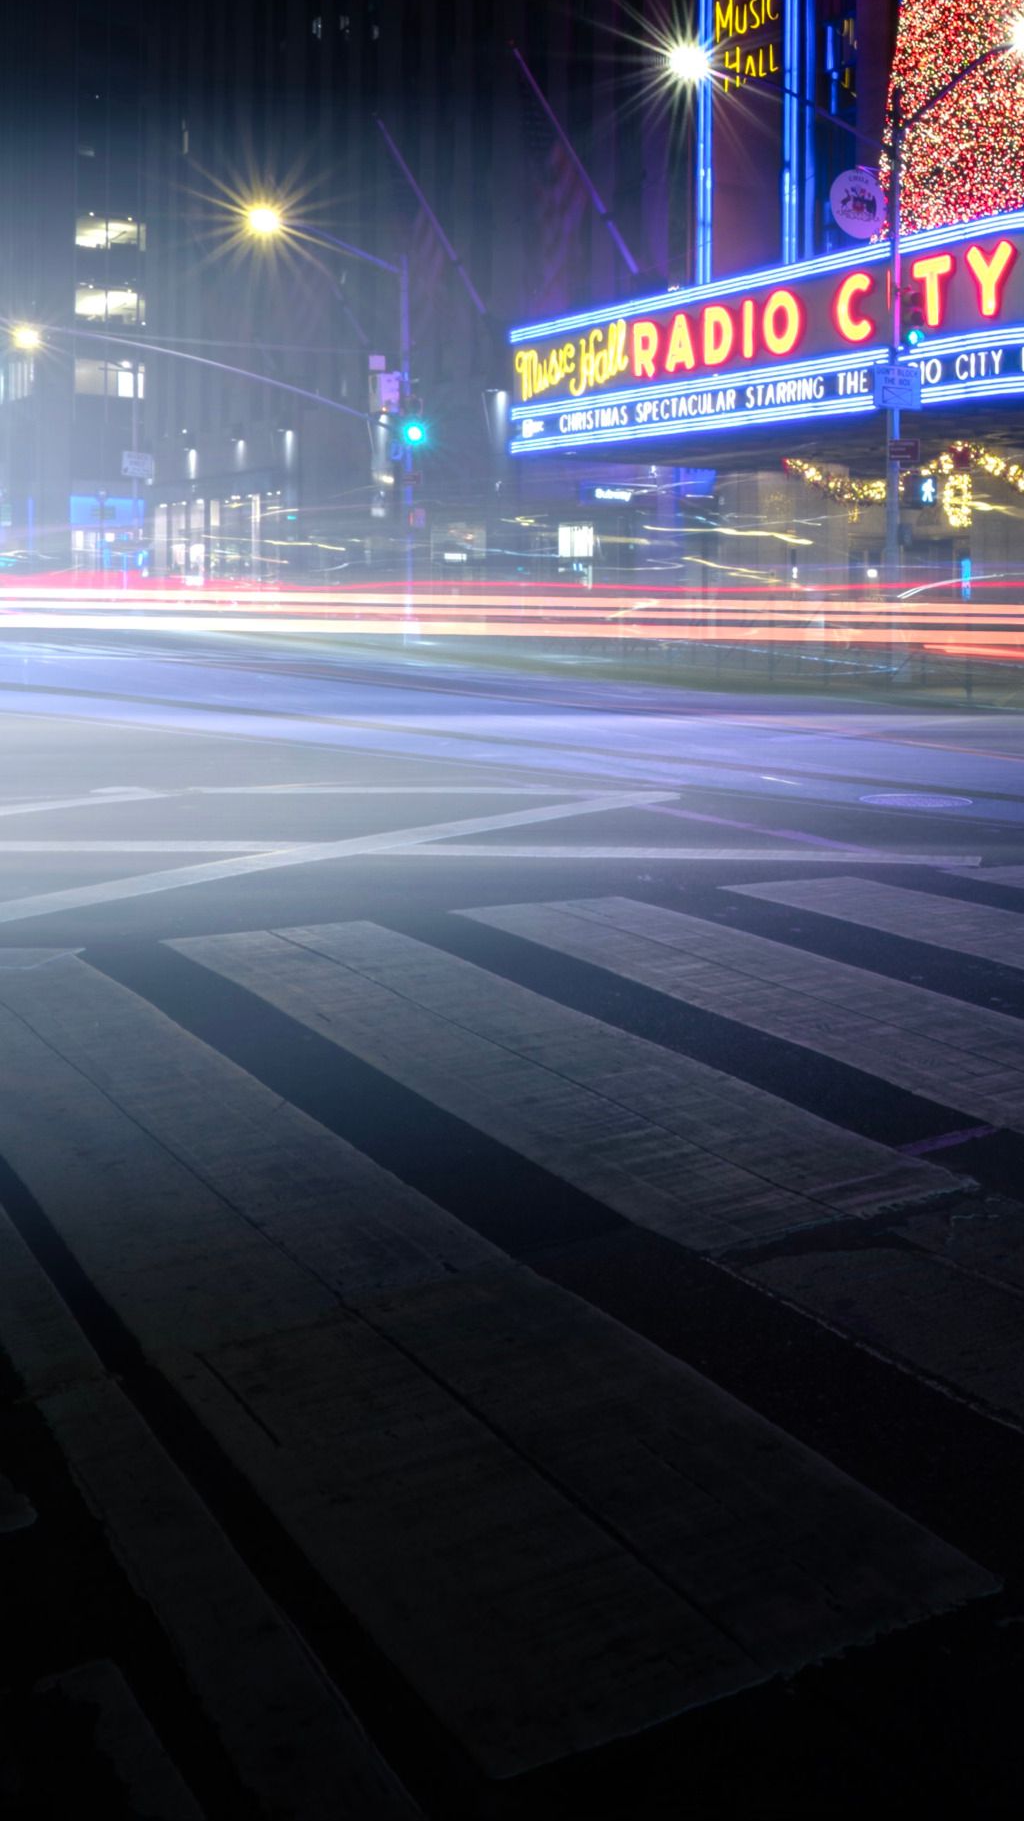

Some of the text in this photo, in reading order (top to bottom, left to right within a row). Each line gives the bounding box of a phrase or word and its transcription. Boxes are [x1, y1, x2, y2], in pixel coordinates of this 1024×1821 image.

[632, 239, 1014, 378] RADIO CTY
[515, 319, 629, 401] Music Hall
[559, 405, 629, 434] CHRISTMAS
[635, 389, 737, 422] SPECTACULAR
[745, 376, 825, 409] STARRING
[837, 369, 869, 395] THE
[955, 348, 1003, 380] CITY
